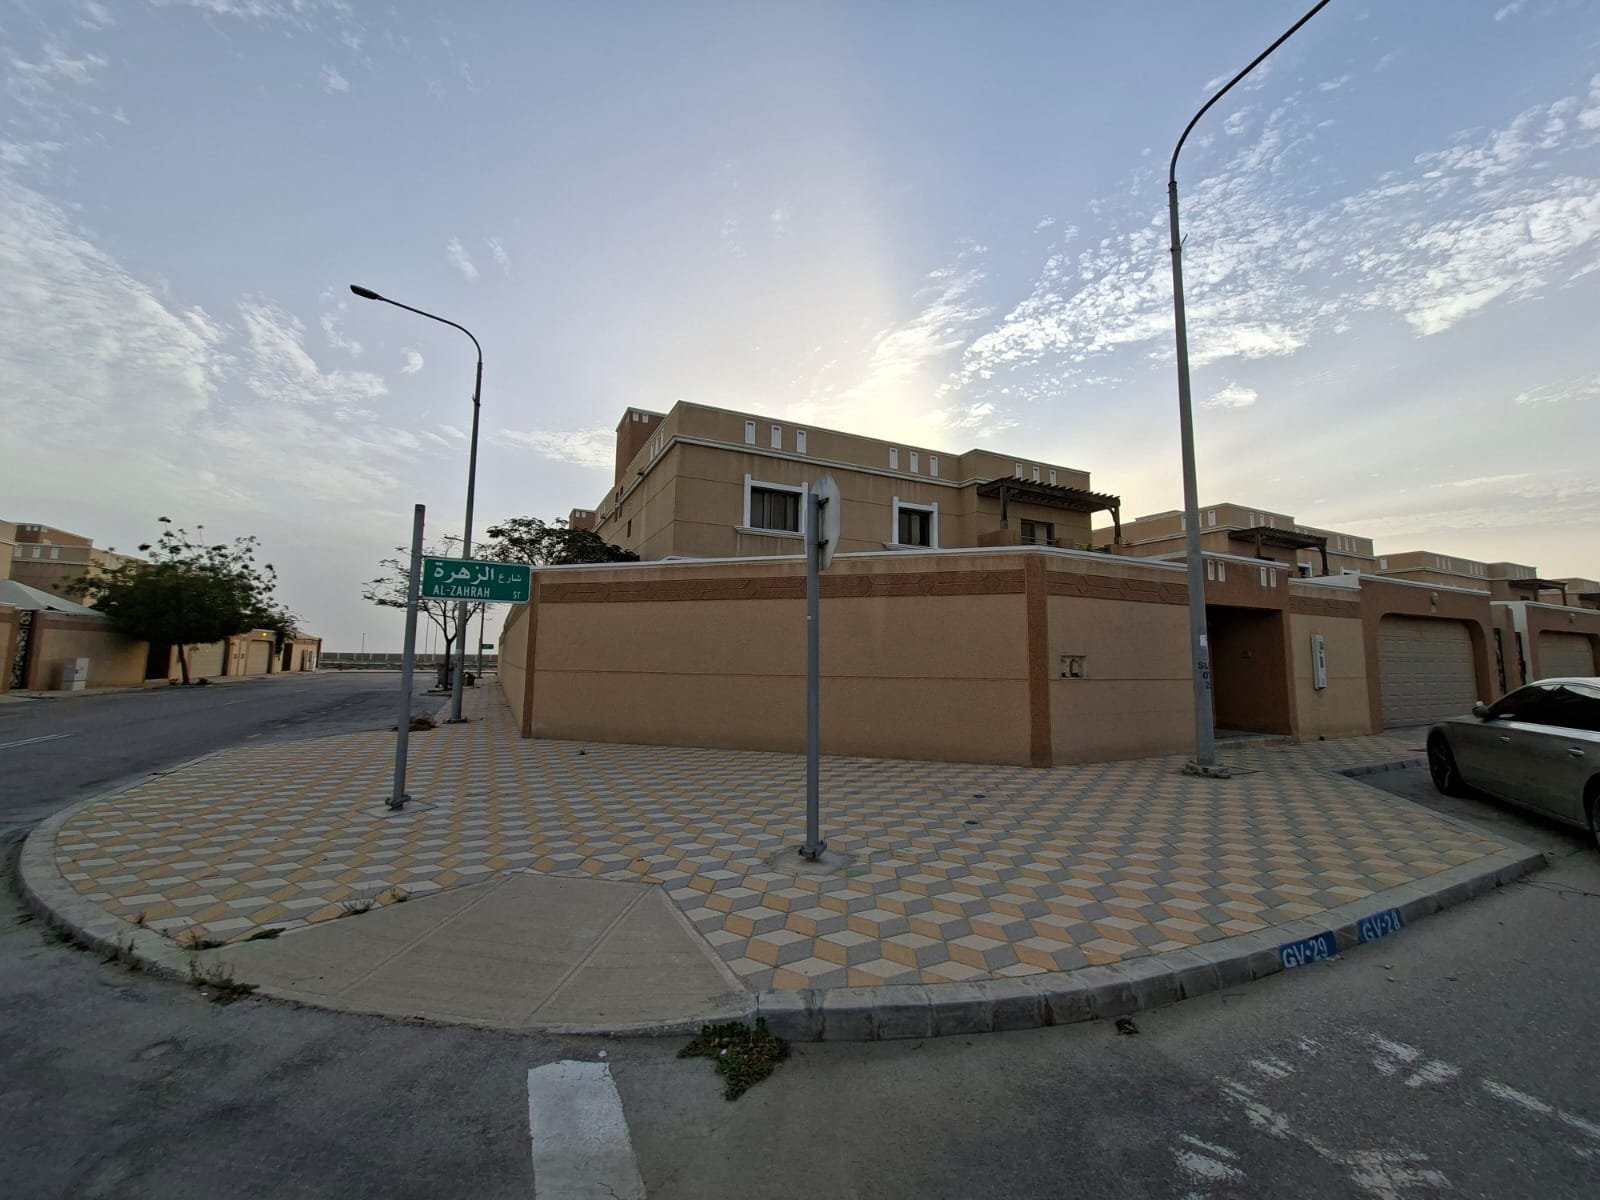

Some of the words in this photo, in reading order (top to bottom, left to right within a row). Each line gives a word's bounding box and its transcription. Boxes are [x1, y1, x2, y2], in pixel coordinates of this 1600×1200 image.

[433, 562, 495, 585] الزهرة
[498, 573, 522, 584] شارع
[432, 584, 490, 598] AL-ZAHRAH
[513, 591, 521, 600] ST
